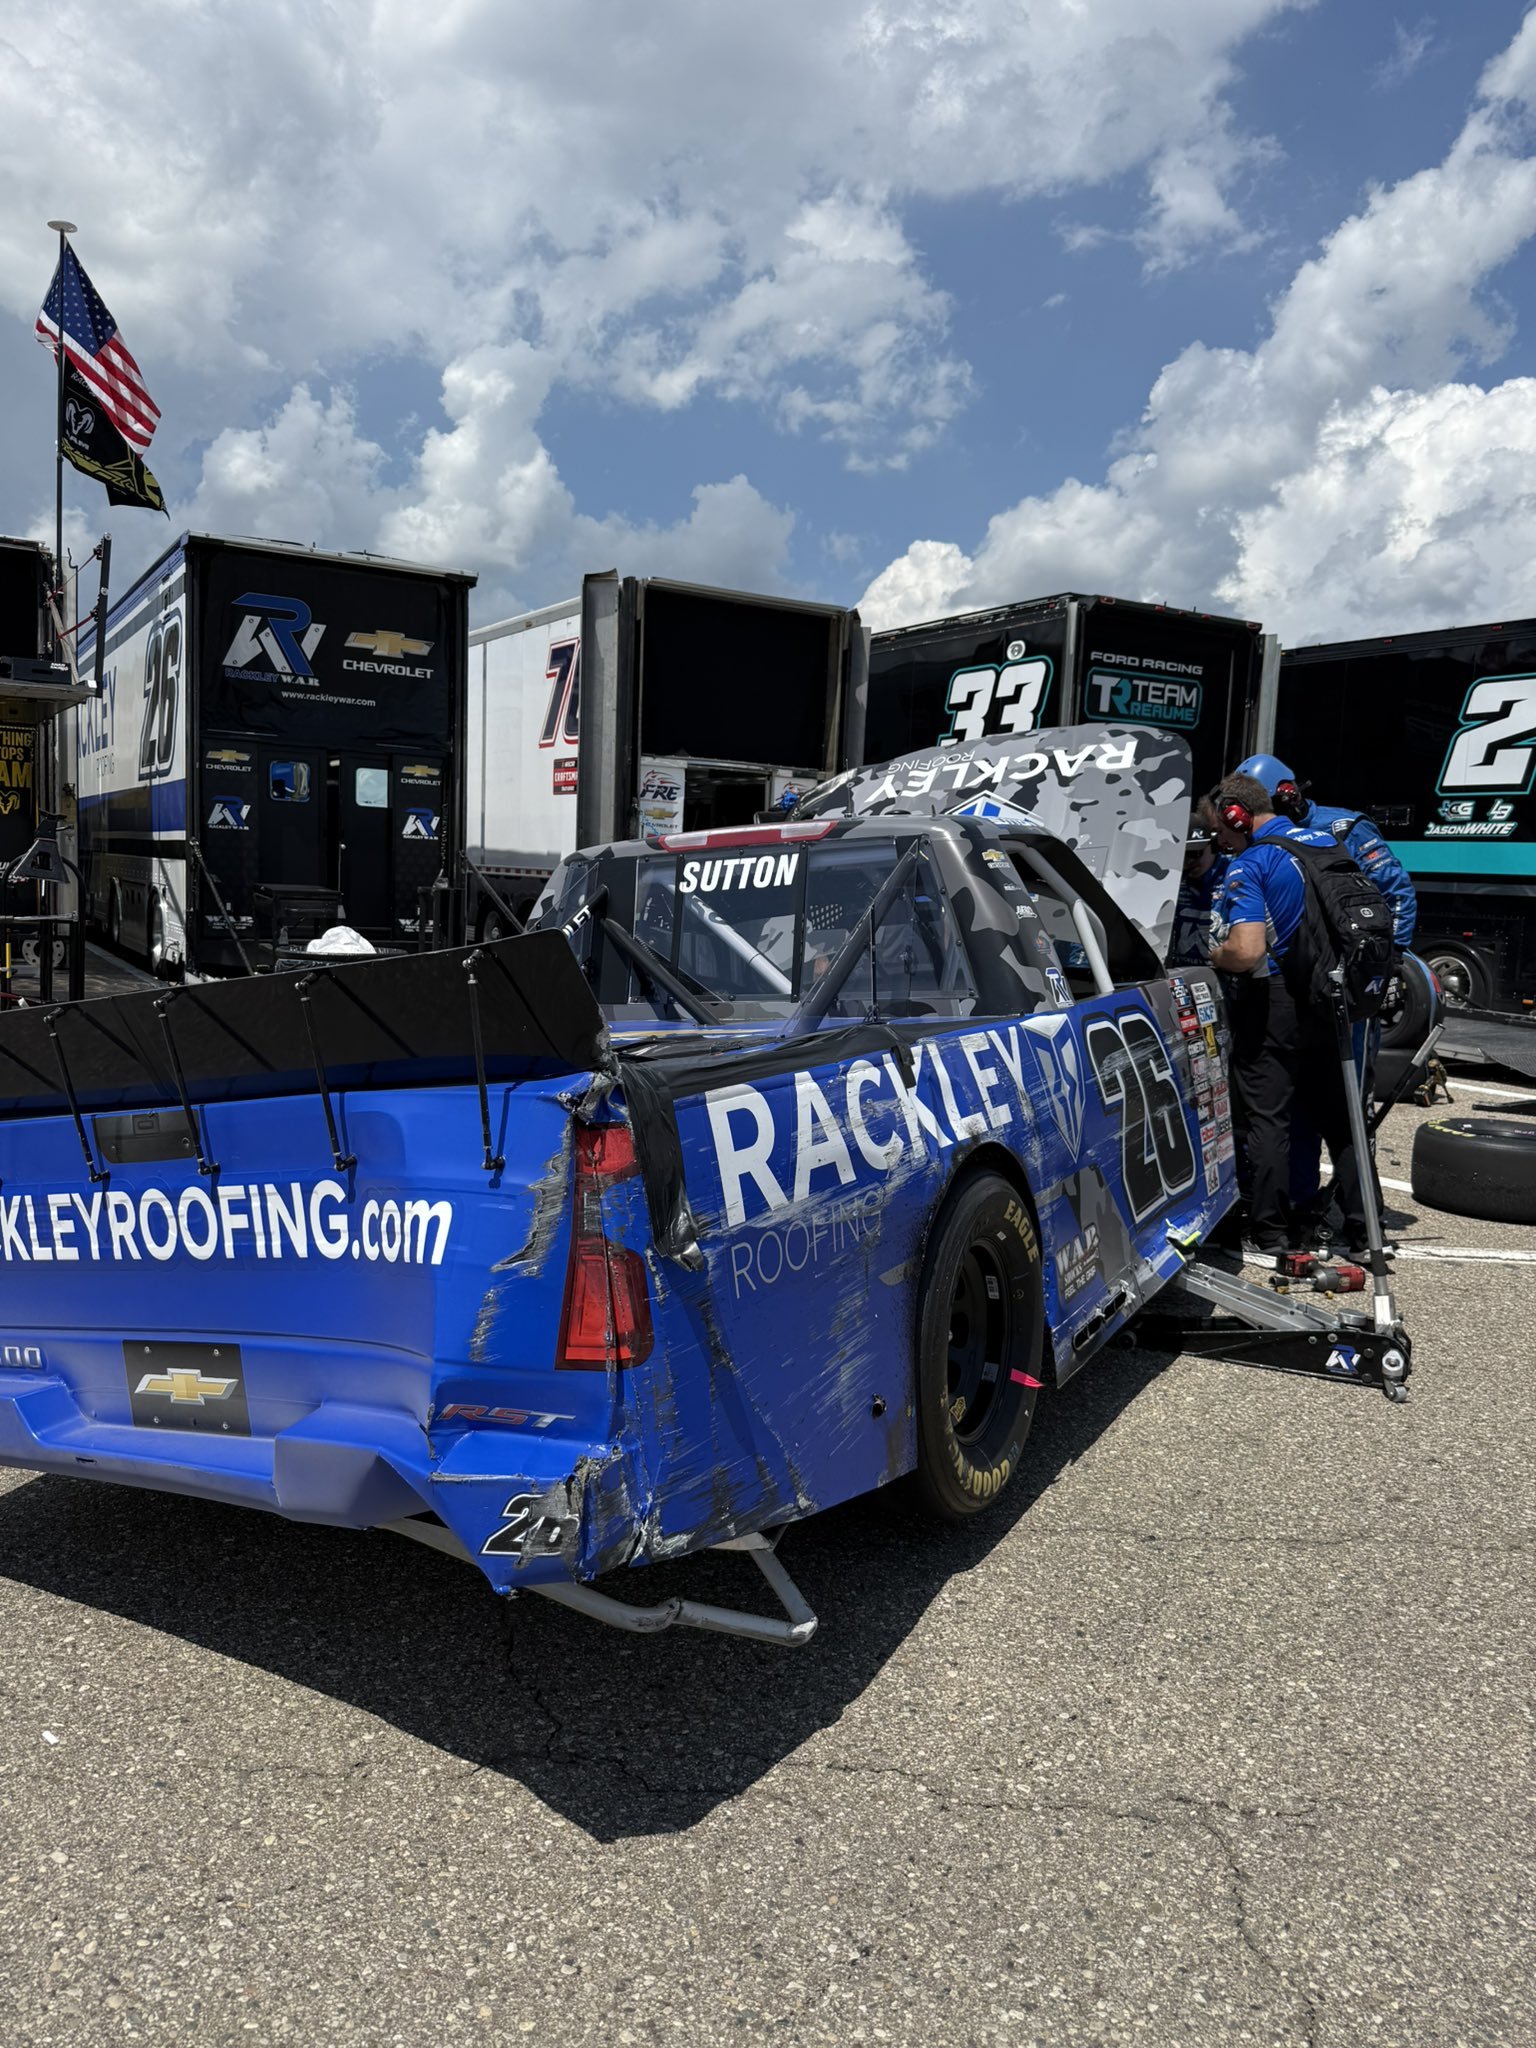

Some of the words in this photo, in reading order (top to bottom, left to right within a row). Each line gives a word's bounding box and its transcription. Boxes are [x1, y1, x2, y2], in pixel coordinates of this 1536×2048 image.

[225, 667, 280, 684] RACKLEY
[342, 659, 434, 680] CHEVROLET
[1090, 651, 1139, 668] FORD
[1142, 658, 1204, 676] RACING
[139, 613, 182, 780] 26
[281, 690, 377, 708] www.rackleywar.com
[939, 656, 1053, 747] 33
[1133, 678, 1198, 709] TEAM
[1130, 700, 1196, 722] REAUME
[0, 730, 32, 748] HING
[1437, 674, 1536, 795] 2
[0, 746, 24, 761] OPS
[888, 749, 975, 774] ROOFING
[205, 763, 251, 773] CHEVROLET
[554, 771, 579, 782] CRAFTSM
[864, 740, 1138, 803] RACKLEY
[400, 777, 442, 787] CHEVROLET
[640, 783, 681, 801] FRE
[678, 852, 799, 894] SUTTON
[1198, 1004, 1216, 1023] SKF
[705, 1026, 1035, 1228] RACKLEY
[1085, 1011, 1197, 1224] 26
[0, 1179, 453, 1266] KLEYROOFING.com
[1003, 1199, 1040, 1264] EAGLE
[731, 1190, 886, 1300] ROOFING
[0, 1345, 42, 1369] 00
[437, 1402, 577, 1429] RST
